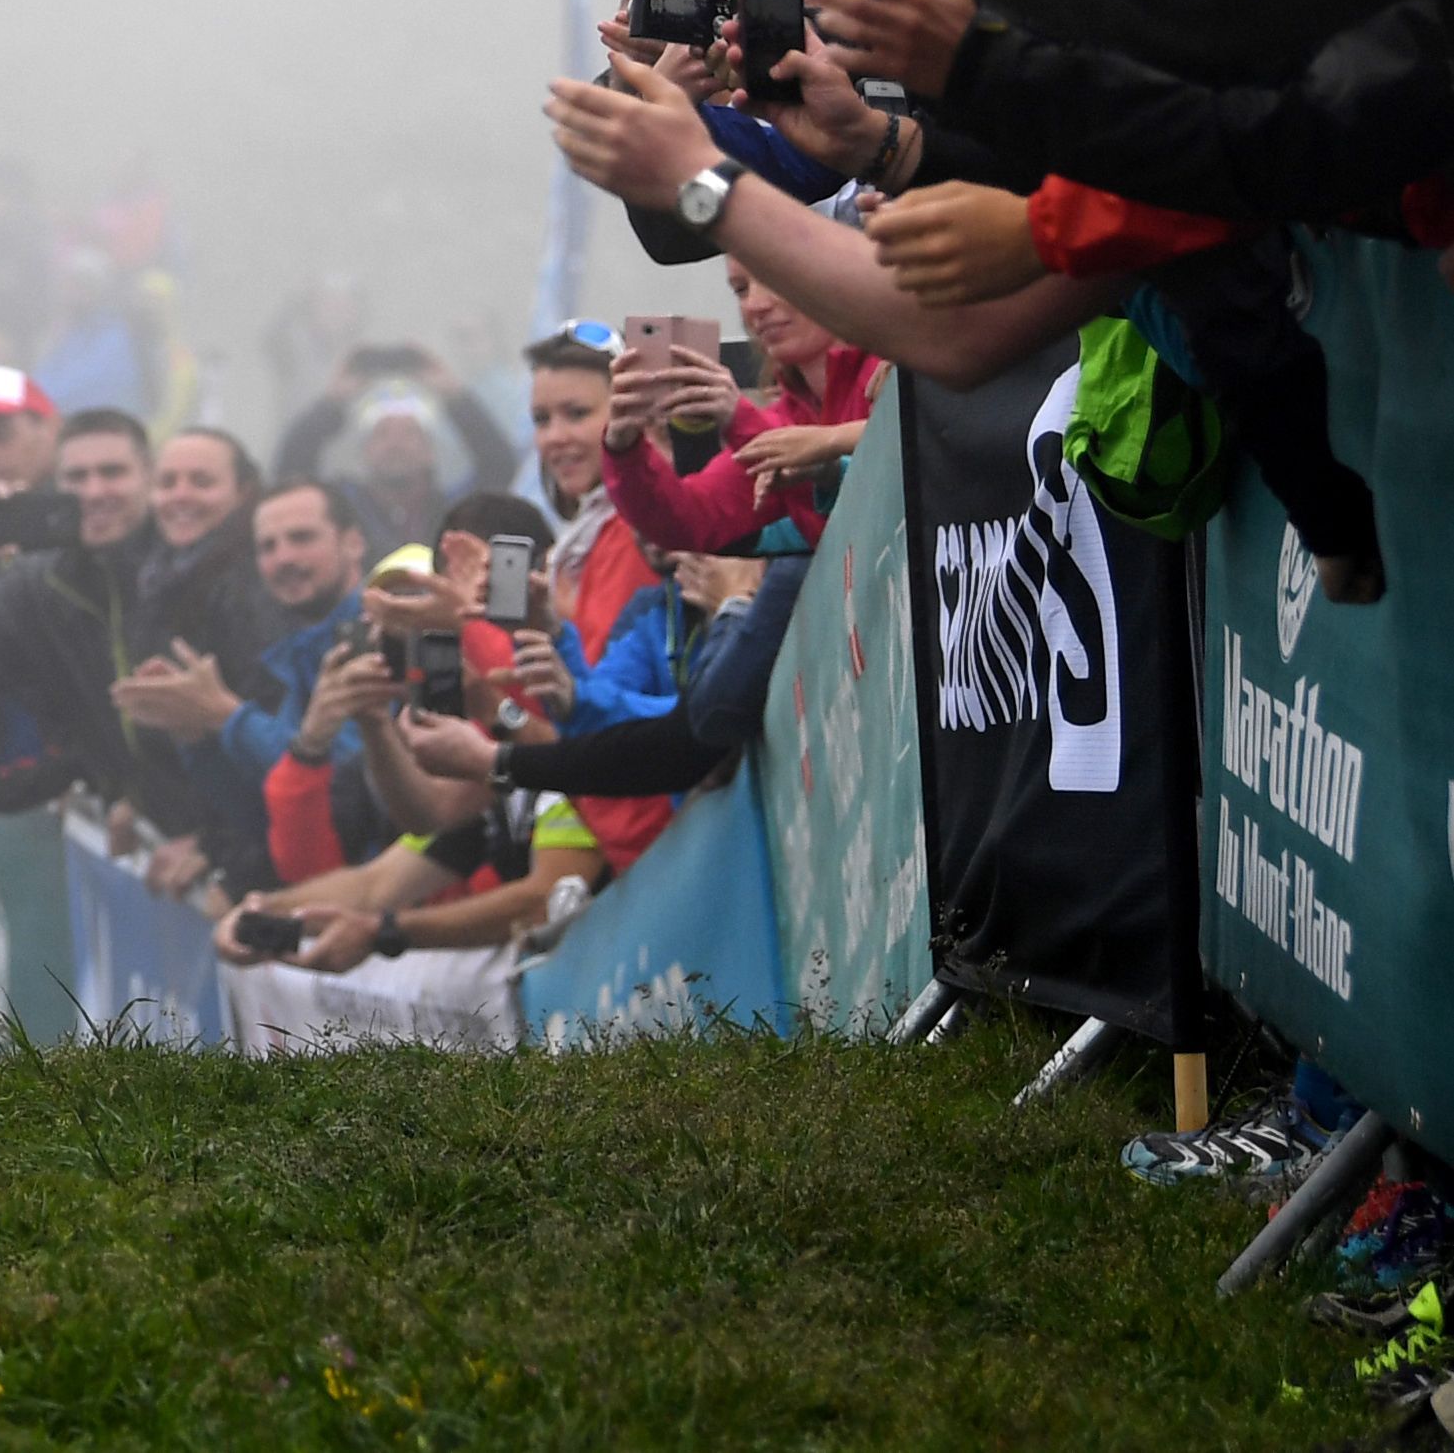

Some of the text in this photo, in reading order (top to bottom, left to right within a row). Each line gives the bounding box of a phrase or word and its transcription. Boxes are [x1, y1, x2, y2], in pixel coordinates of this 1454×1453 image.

[1222, 624, 1363, 863] Marathon
[1215, 793, 1240, 909] Du
[1242, 813, 1353, 1003] Mont-Blanc
